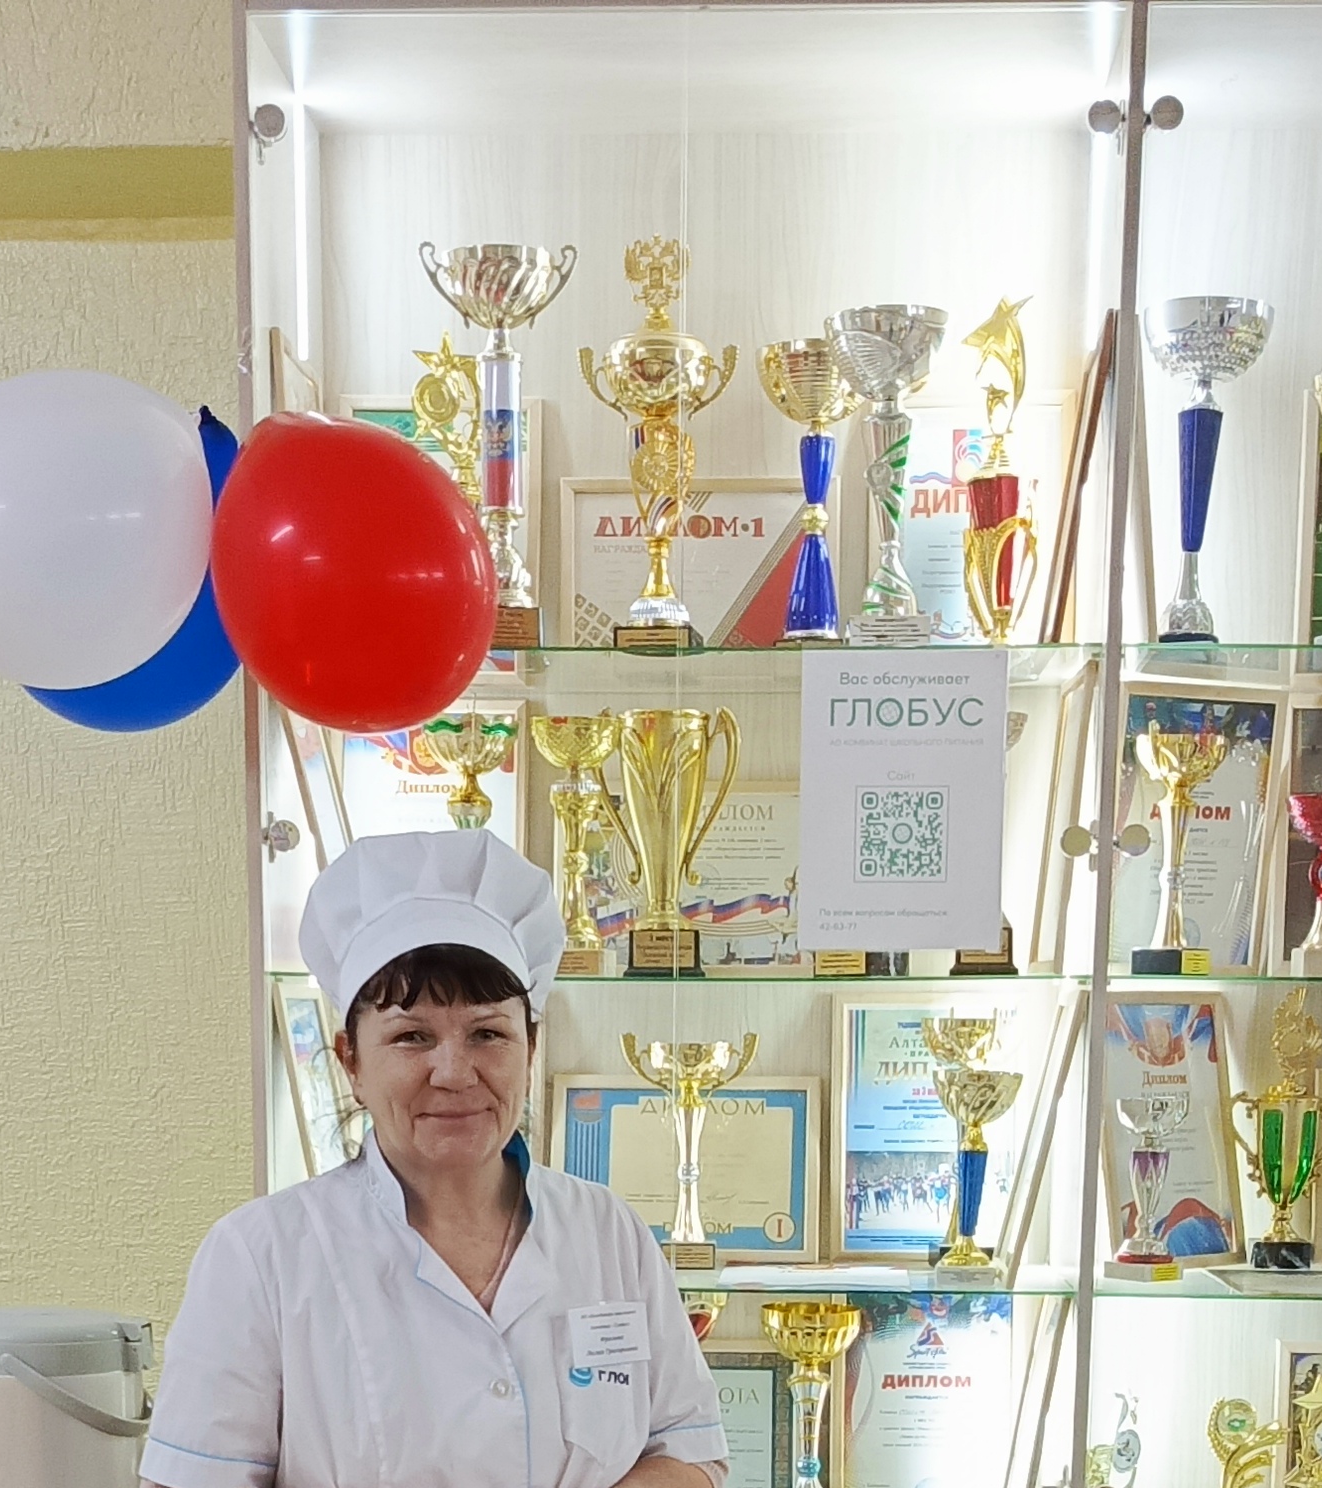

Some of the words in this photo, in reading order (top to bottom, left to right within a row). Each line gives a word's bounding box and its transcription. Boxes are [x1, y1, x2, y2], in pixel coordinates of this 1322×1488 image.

[839, 672, 869, 686] Вас
[873, 671, 970, 688] обслуживает
[829, 697, 984, 729] ГЛОБУС
[886, 770, 916, 781] Сайт
[598, 1369, 630, 1386] ГЛО
[881, 1373, 972, 1390] ДИПЛОМ
